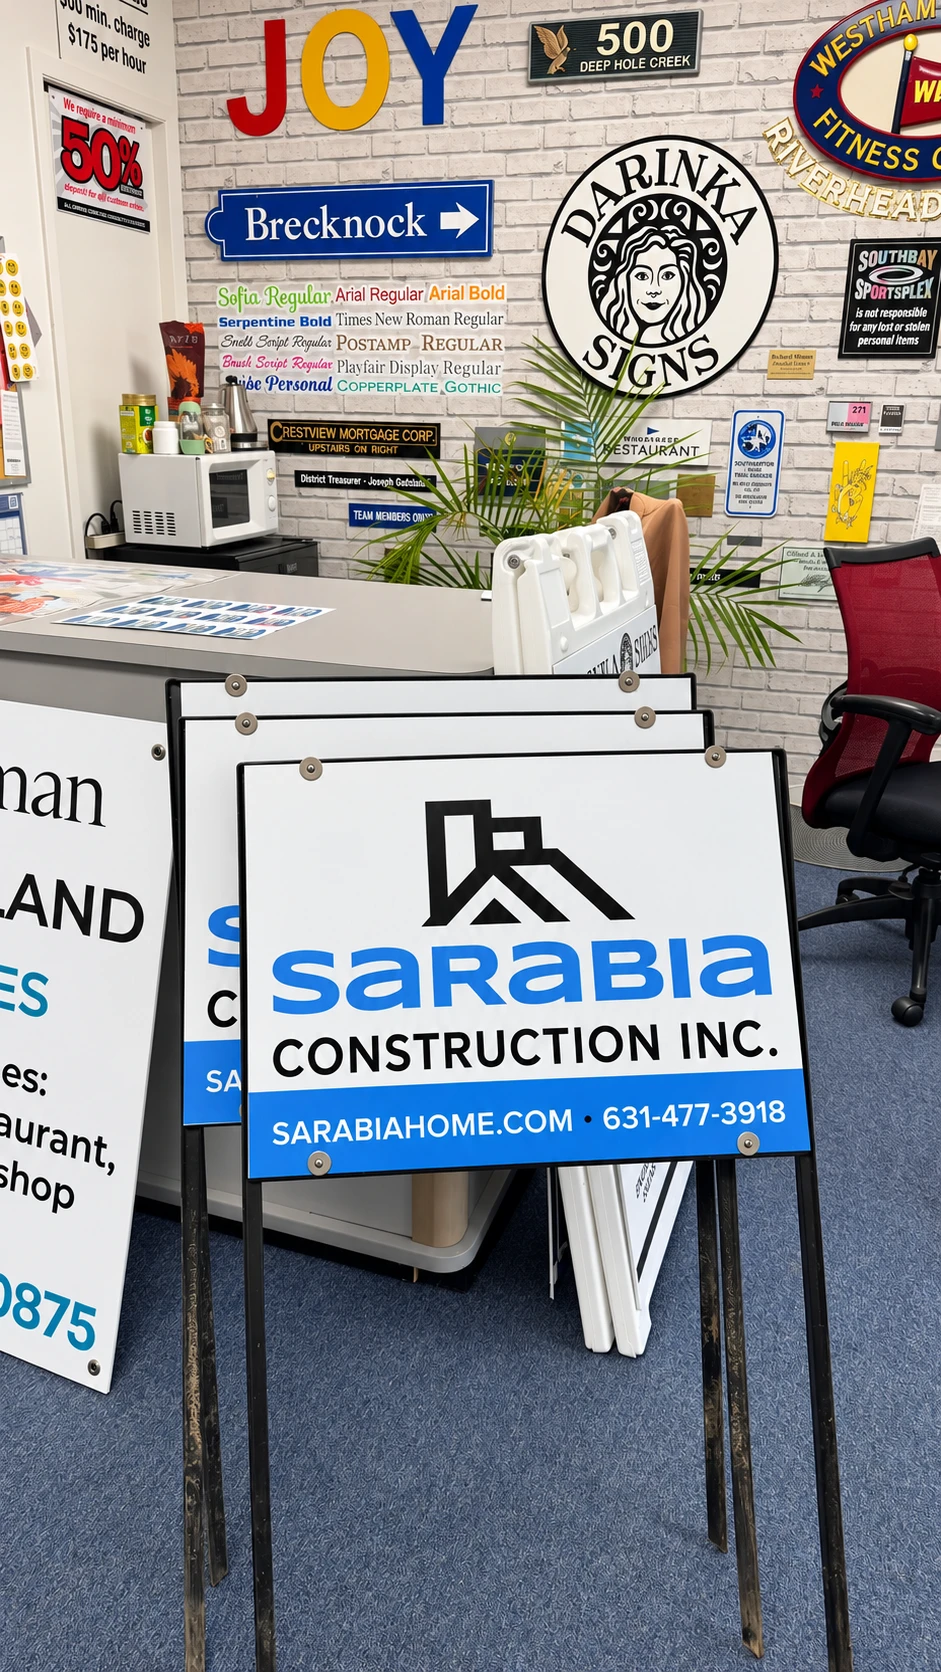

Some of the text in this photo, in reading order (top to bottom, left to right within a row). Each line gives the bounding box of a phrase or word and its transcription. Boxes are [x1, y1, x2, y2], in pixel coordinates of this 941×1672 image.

[86, 4, 111, 29] min.
[114, 16, 150, 48] charge
[596, 19, 674, 56] 500
[68, 22, 147, 74] $175 per hour
[227, 4, 478, 137] JOY
[580, 55, 691, 73] DEEP HOLE CREEK
[63, 97, 75, 112] We
[76, 105, 101, 121] require
[813, 107, 920, 171] FITNESS
[60, 115, 143, 191] 50%
[762, 117, 941, 222] RIVERHEAD
[561, 148, 758, 248] DARINKA
[244, 202, 427, 241] Brecknock
[857, 249, 938, 272] SOUTHBAY
[218, 284, 331, 313] Sofia Regular
[335, 287, 424, 304] Arial Regular
[429, 285, 505, 300] Arial Bold
[854, 277, 934, 300] SPORTSPLEX
[219, 316, 332, 329] Serpentine Bold
[336, 311, 504, 329] Times New Roman Regular
[856, 307, 928, 320] is not responsible
[849, 321, 931, 334] for any lost or stolen
[292, 335, 332, 353] Regular
[857, 334, 919, 348] personal items
[292, 356, 333, 373] Regular
[337, 359, 502, 378] Playfair Display Regular
[582, 334, 719, 388] SIGNS
[265, 374, 333, 391] Personal
[270, 421, 435, 442] CRESTVIEW MORTGAGE CORP.
[308, 443, 398, 454] UPSTAIRS ON RIGHT
[300, 474, 326, 484] District
[328, 475, 361, 486] Treasurer
[368, 476, 393, 488] Joseph
[353, 510, 373, 520] TEAM
[0, 873, 145, 943] AND
[272, 1019, 778, 1077] CONSTRUCTION INC.
[1, 1063, 48, 1096] es:
[272, 1099, 786, 1145] SARABIAHOME.COM 631-477-3918
[0, 1160, 75, 1214] shop
